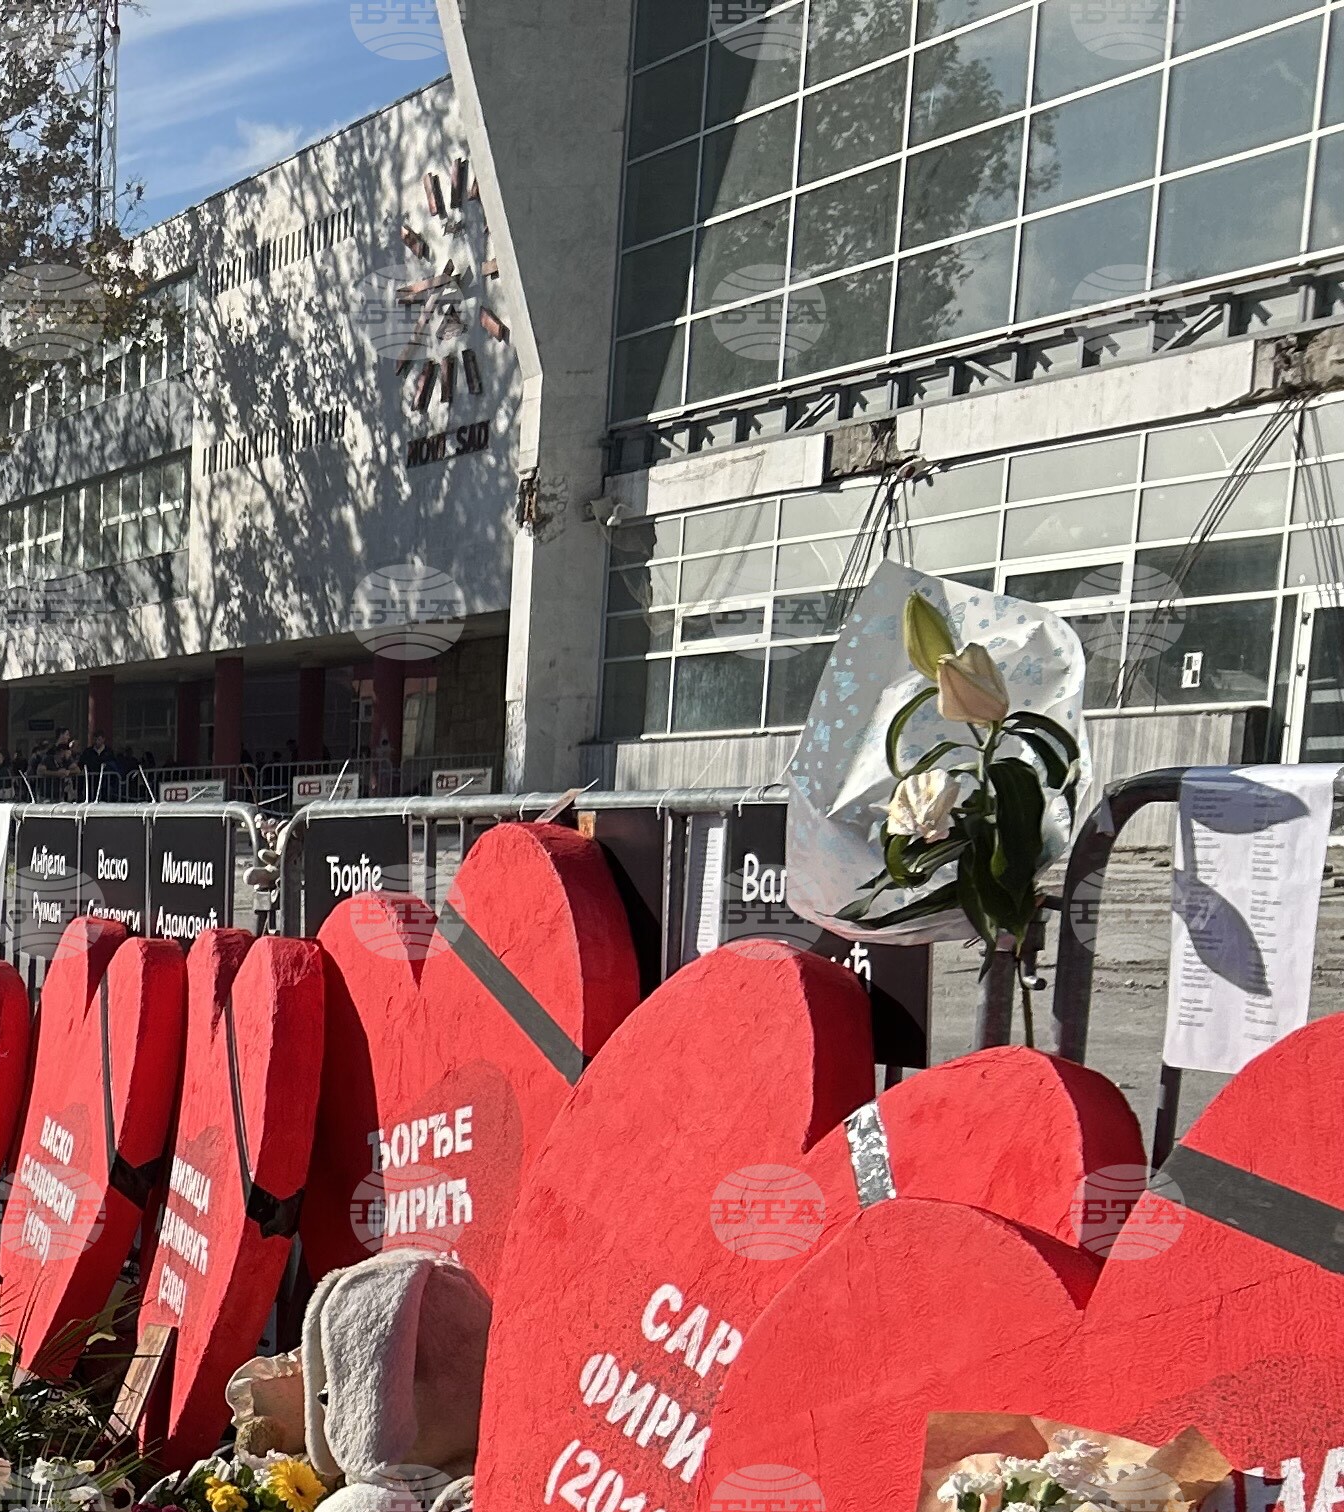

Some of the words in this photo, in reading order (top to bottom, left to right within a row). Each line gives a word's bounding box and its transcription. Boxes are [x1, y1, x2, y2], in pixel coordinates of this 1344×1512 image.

[455, 422, 491, 459] SAD
[30, 845, 66, 880] Анђела
[97, 848, 128, 882] Васко
[161, 851, 214, 890] Милица
[326, 852, 383, 897] Ђорђе
[32, 891, 61, 929] Руман
[40, 1114, 74, 1166] ВАСКО
[367, 1104, 474, 1172] ЂОРЂЕ
[20, 1152, 78, 1226] САЗДОВСКИ
[21, 1209, 52, 1267] (1979)
[640, 1283, 744, 1378] САР
[578, 1352, 713, 1484] ФИРИ
